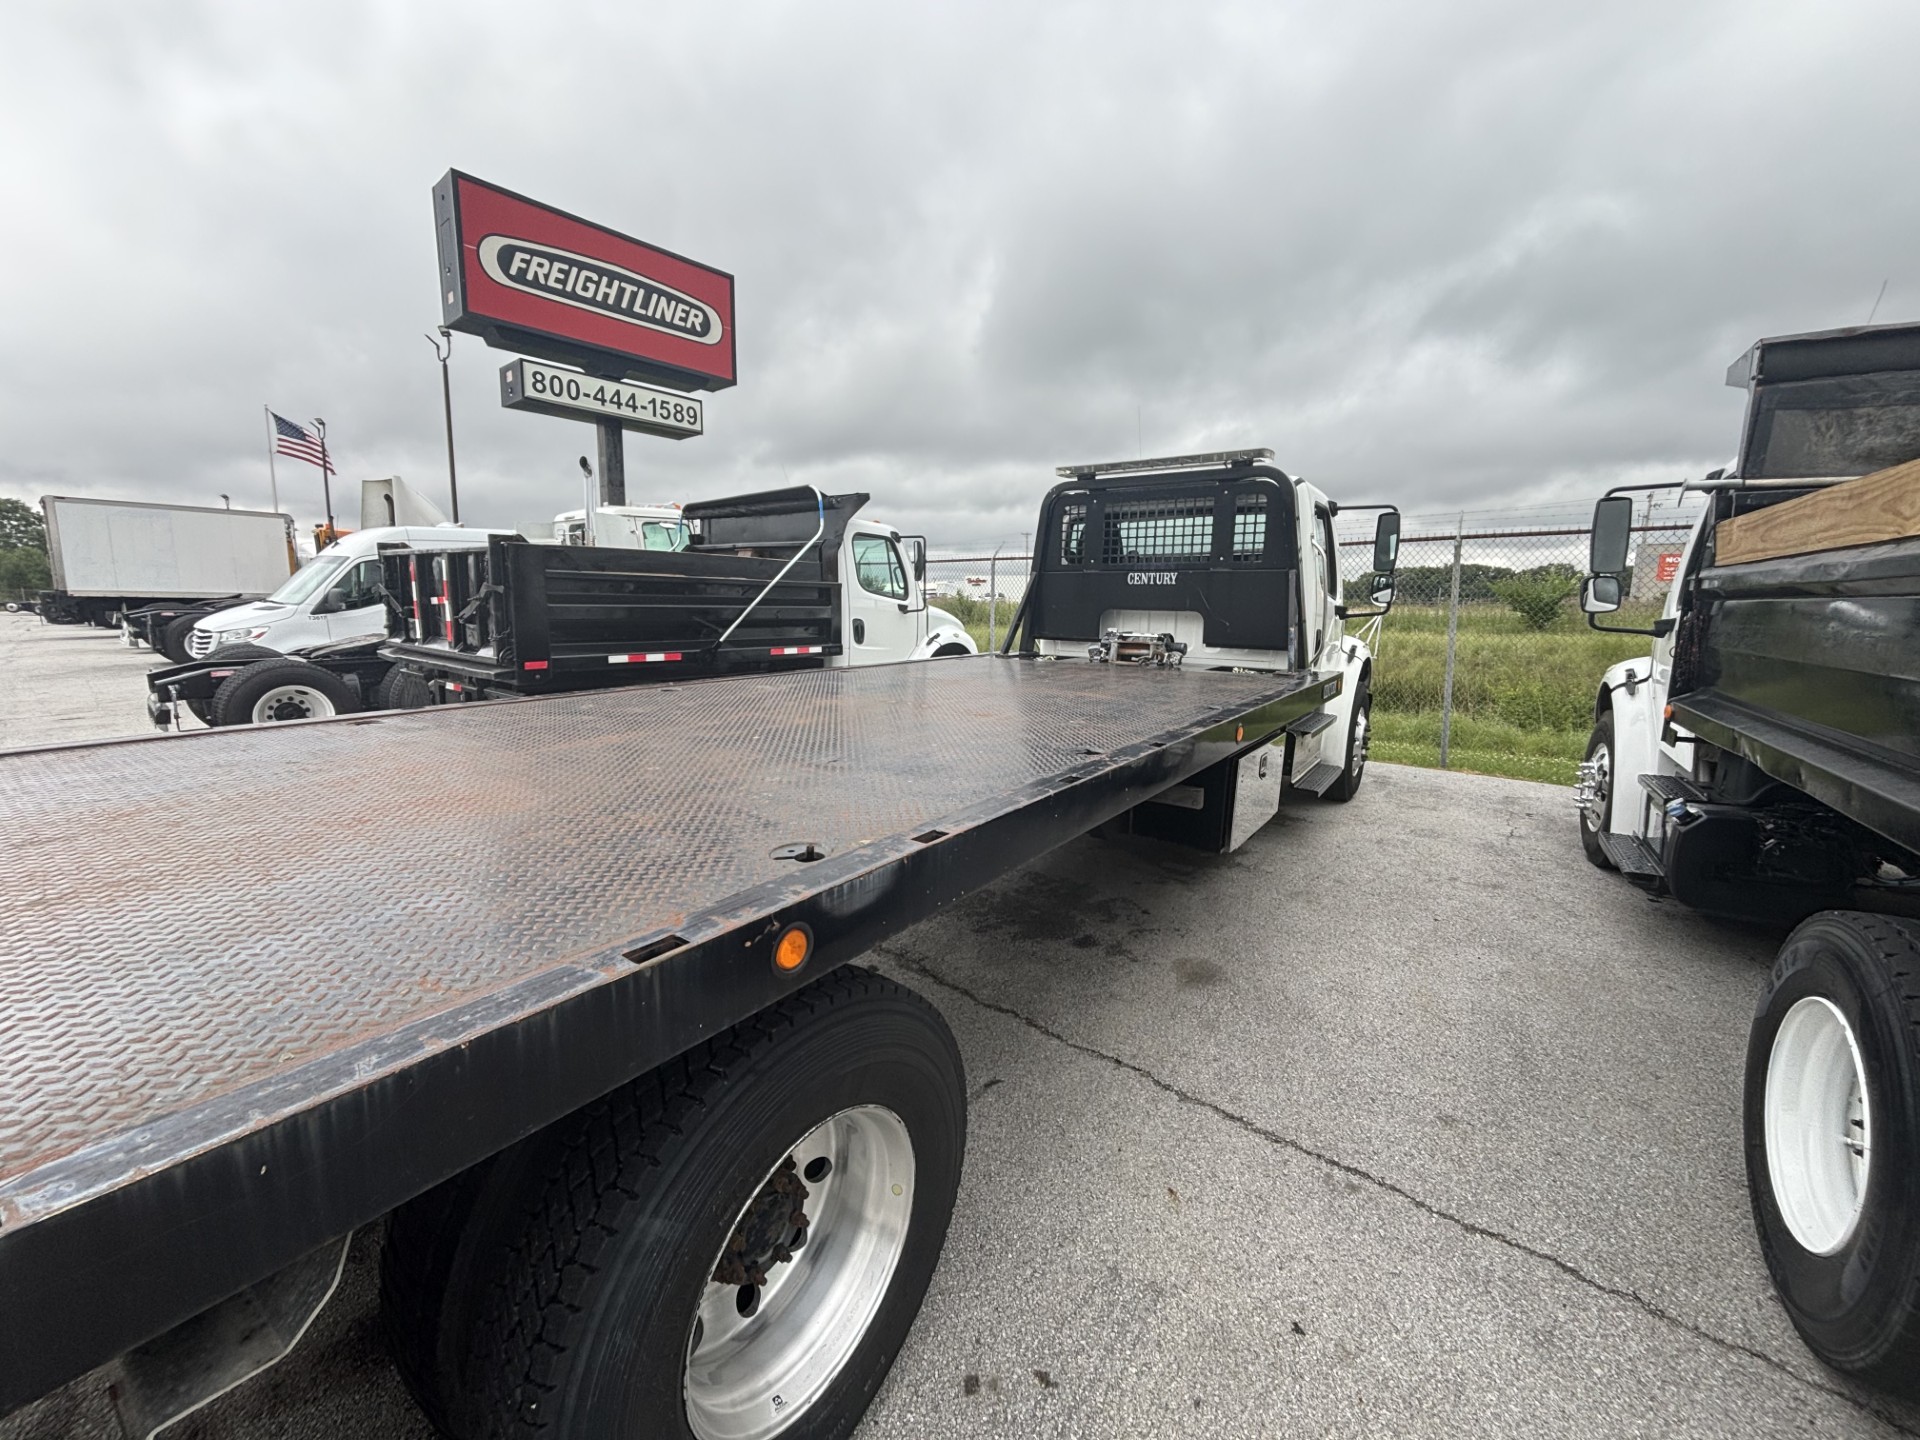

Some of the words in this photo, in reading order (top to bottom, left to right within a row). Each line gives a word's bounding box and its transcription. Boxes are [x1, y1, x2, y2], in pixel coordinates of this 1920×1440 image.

[509, 251, 704, 332] FREIGHTLINER
[531, 370, 698, 426] 800-444-1589
[1127, 572, 1178, 585] CENTURY
